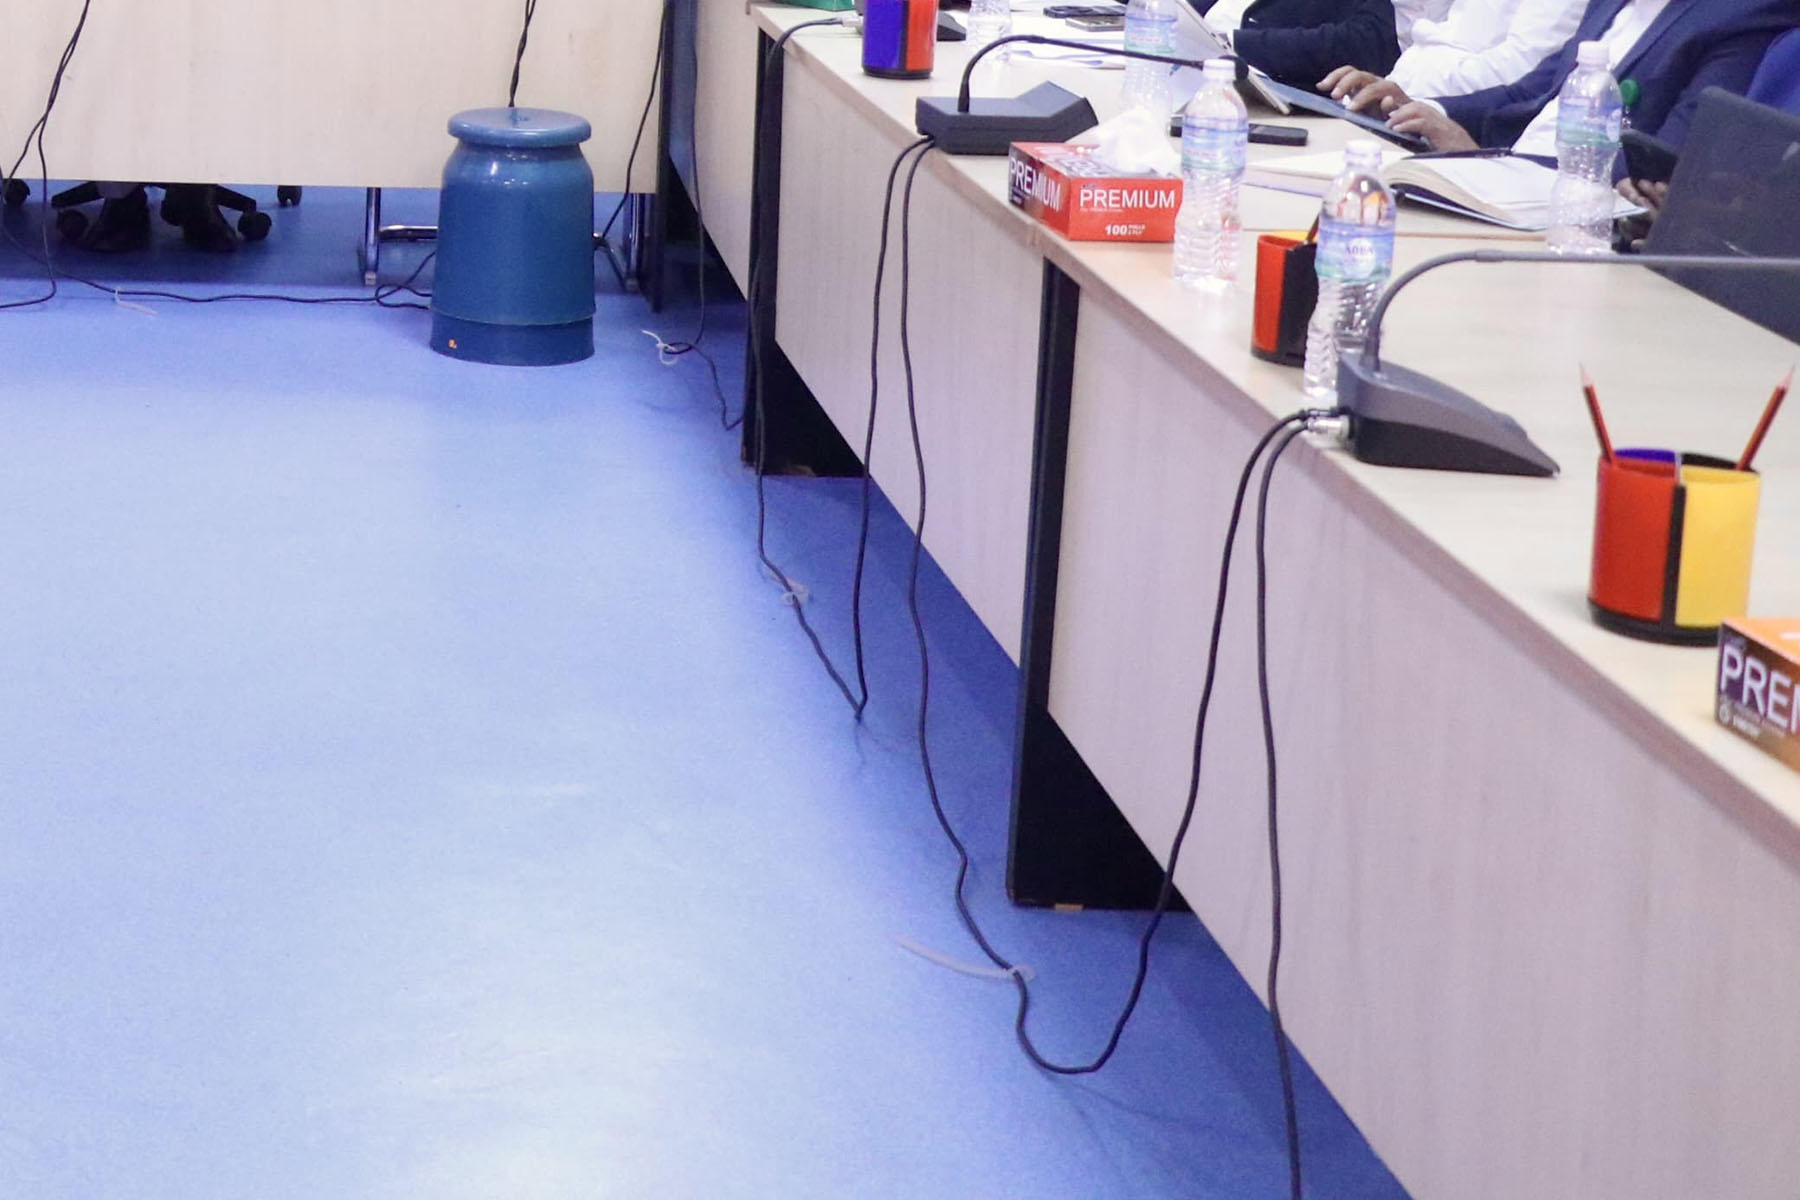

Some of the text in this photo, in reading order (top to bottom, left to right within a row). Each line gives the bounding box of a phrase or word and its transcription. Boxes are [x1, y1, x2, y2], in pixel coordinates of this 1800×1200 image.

[1009, 157, 1061, 211] PREMIUM
[1080, 188, 1175, 209] PREMIUM
[1105, 223, 1127, 236] 100
